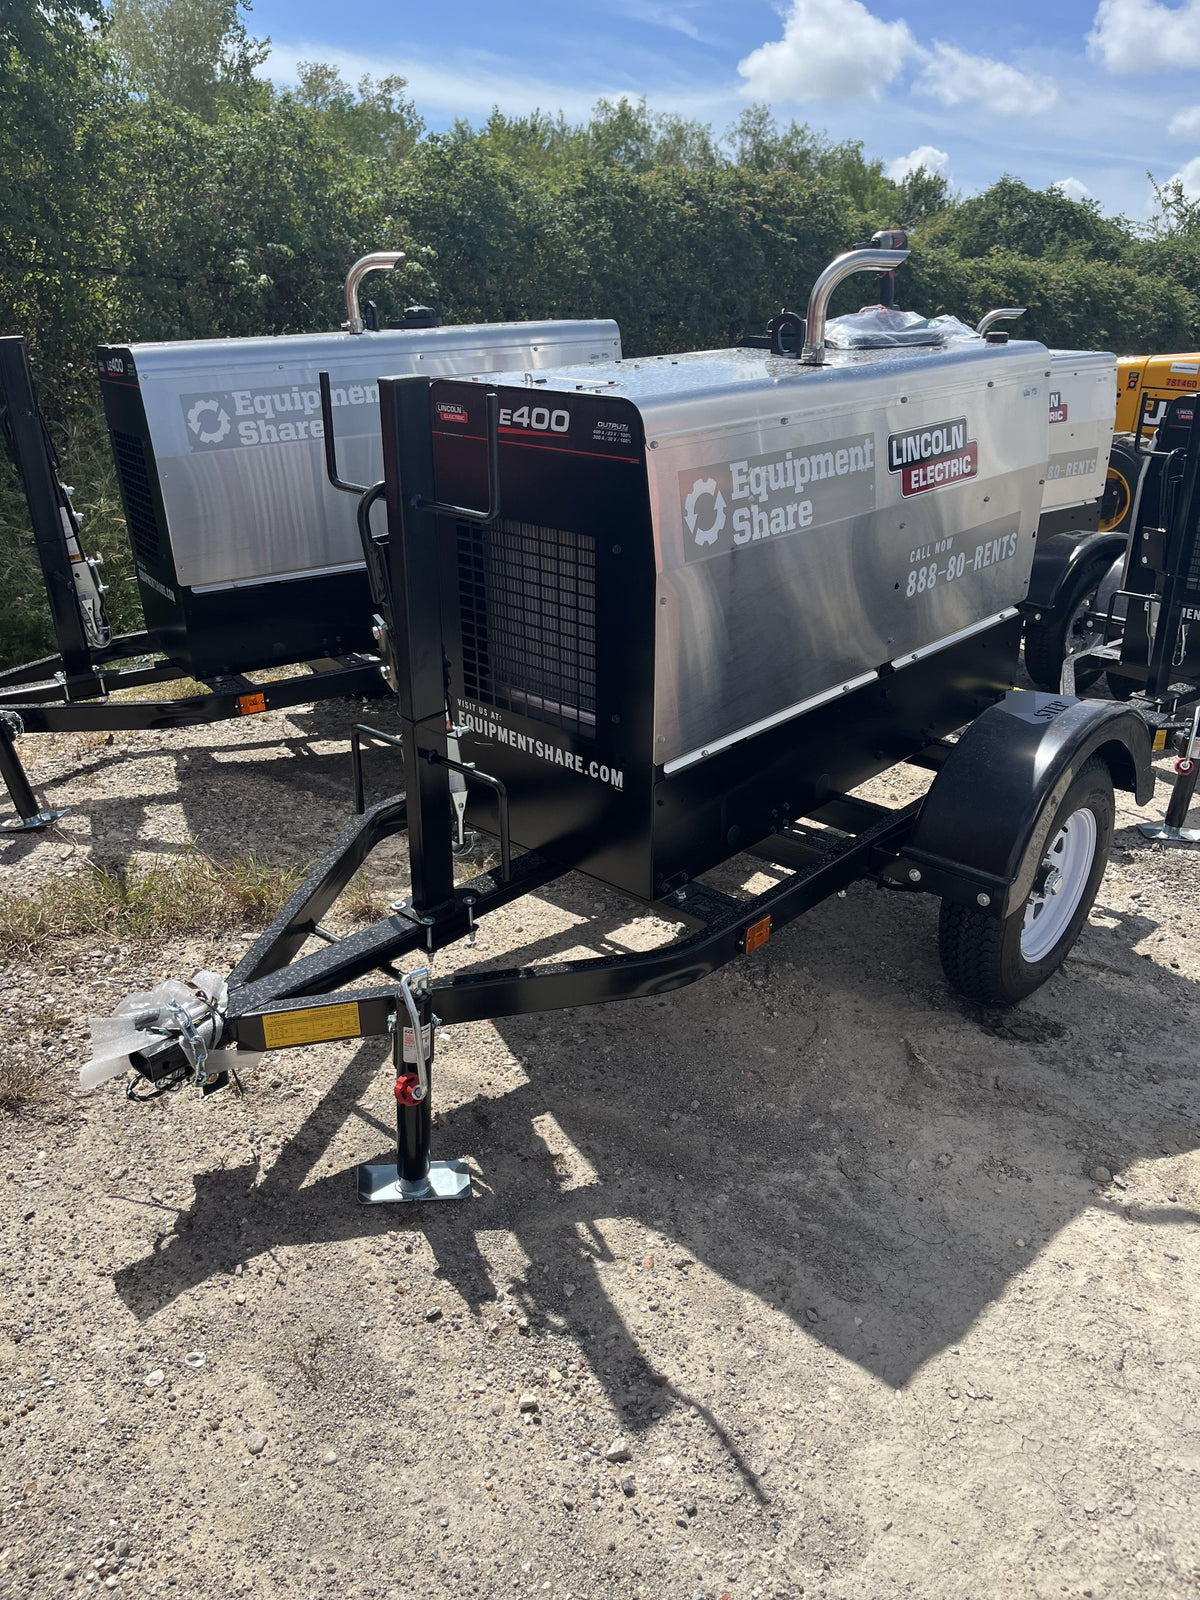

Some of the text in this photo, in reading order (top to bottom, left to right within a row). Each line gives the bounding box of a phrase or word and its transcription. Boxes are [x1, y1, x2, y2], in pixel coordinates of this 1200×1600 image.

[232, 384, 380, 419] Equipmen
[437, 404, 462, 414] LINCOLN
[499, 405, 571, 433] E400
[238, 419, 324, 446] Share
[892, 424, 964, 466] LINCOLN
[729, 438, 874, 502] Equipment
[911, 455, 972, 490] ELECTRIC
[1047, 458, 1096, 479] 80-RENTS
[732, 500, 813, 545] Share
[906, 532, 1018, 597] 888-80-RENTS
[909, 537, 954, 563] CALL NOW
[457, 698, 502, 721] VISIT US AT:
[458, 710, 624, 789] EQUIPMENTSHARE.COM
